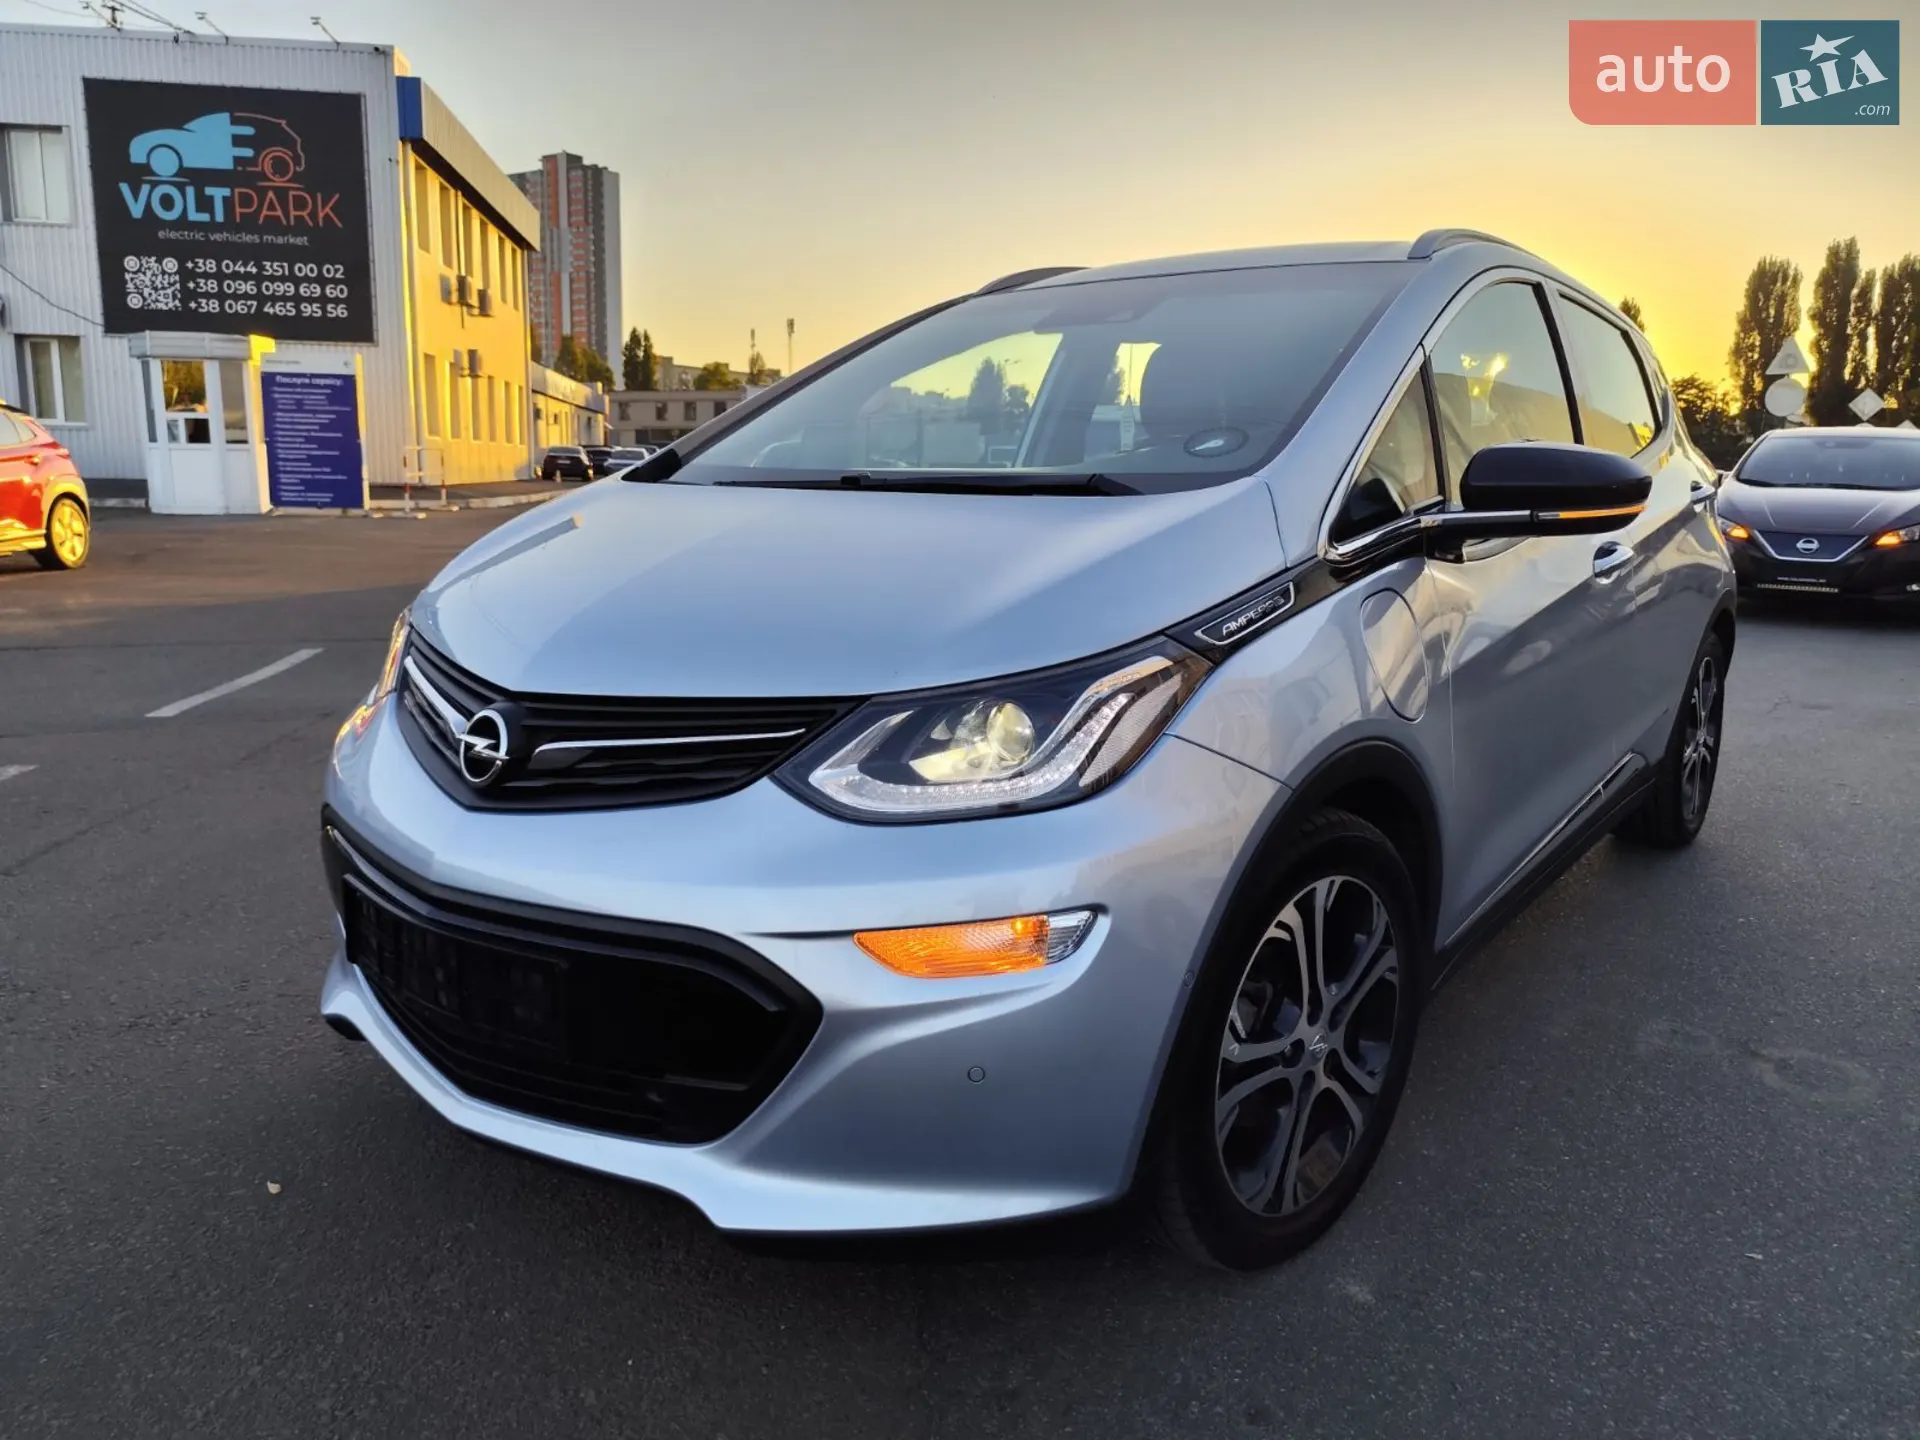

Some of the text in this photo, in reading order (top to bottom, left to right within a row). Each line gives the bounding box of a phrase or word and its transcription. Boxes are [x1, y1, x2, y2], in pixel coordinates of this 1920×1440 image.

[158, 229, 309, 245] electric vehicles market
[185, 259, 345, 279] +38 044 351 00 02
[187, 280, 348, 299] +38 096 099 69 60
[188, 299, 348, 318] +38 067 465 95 56
